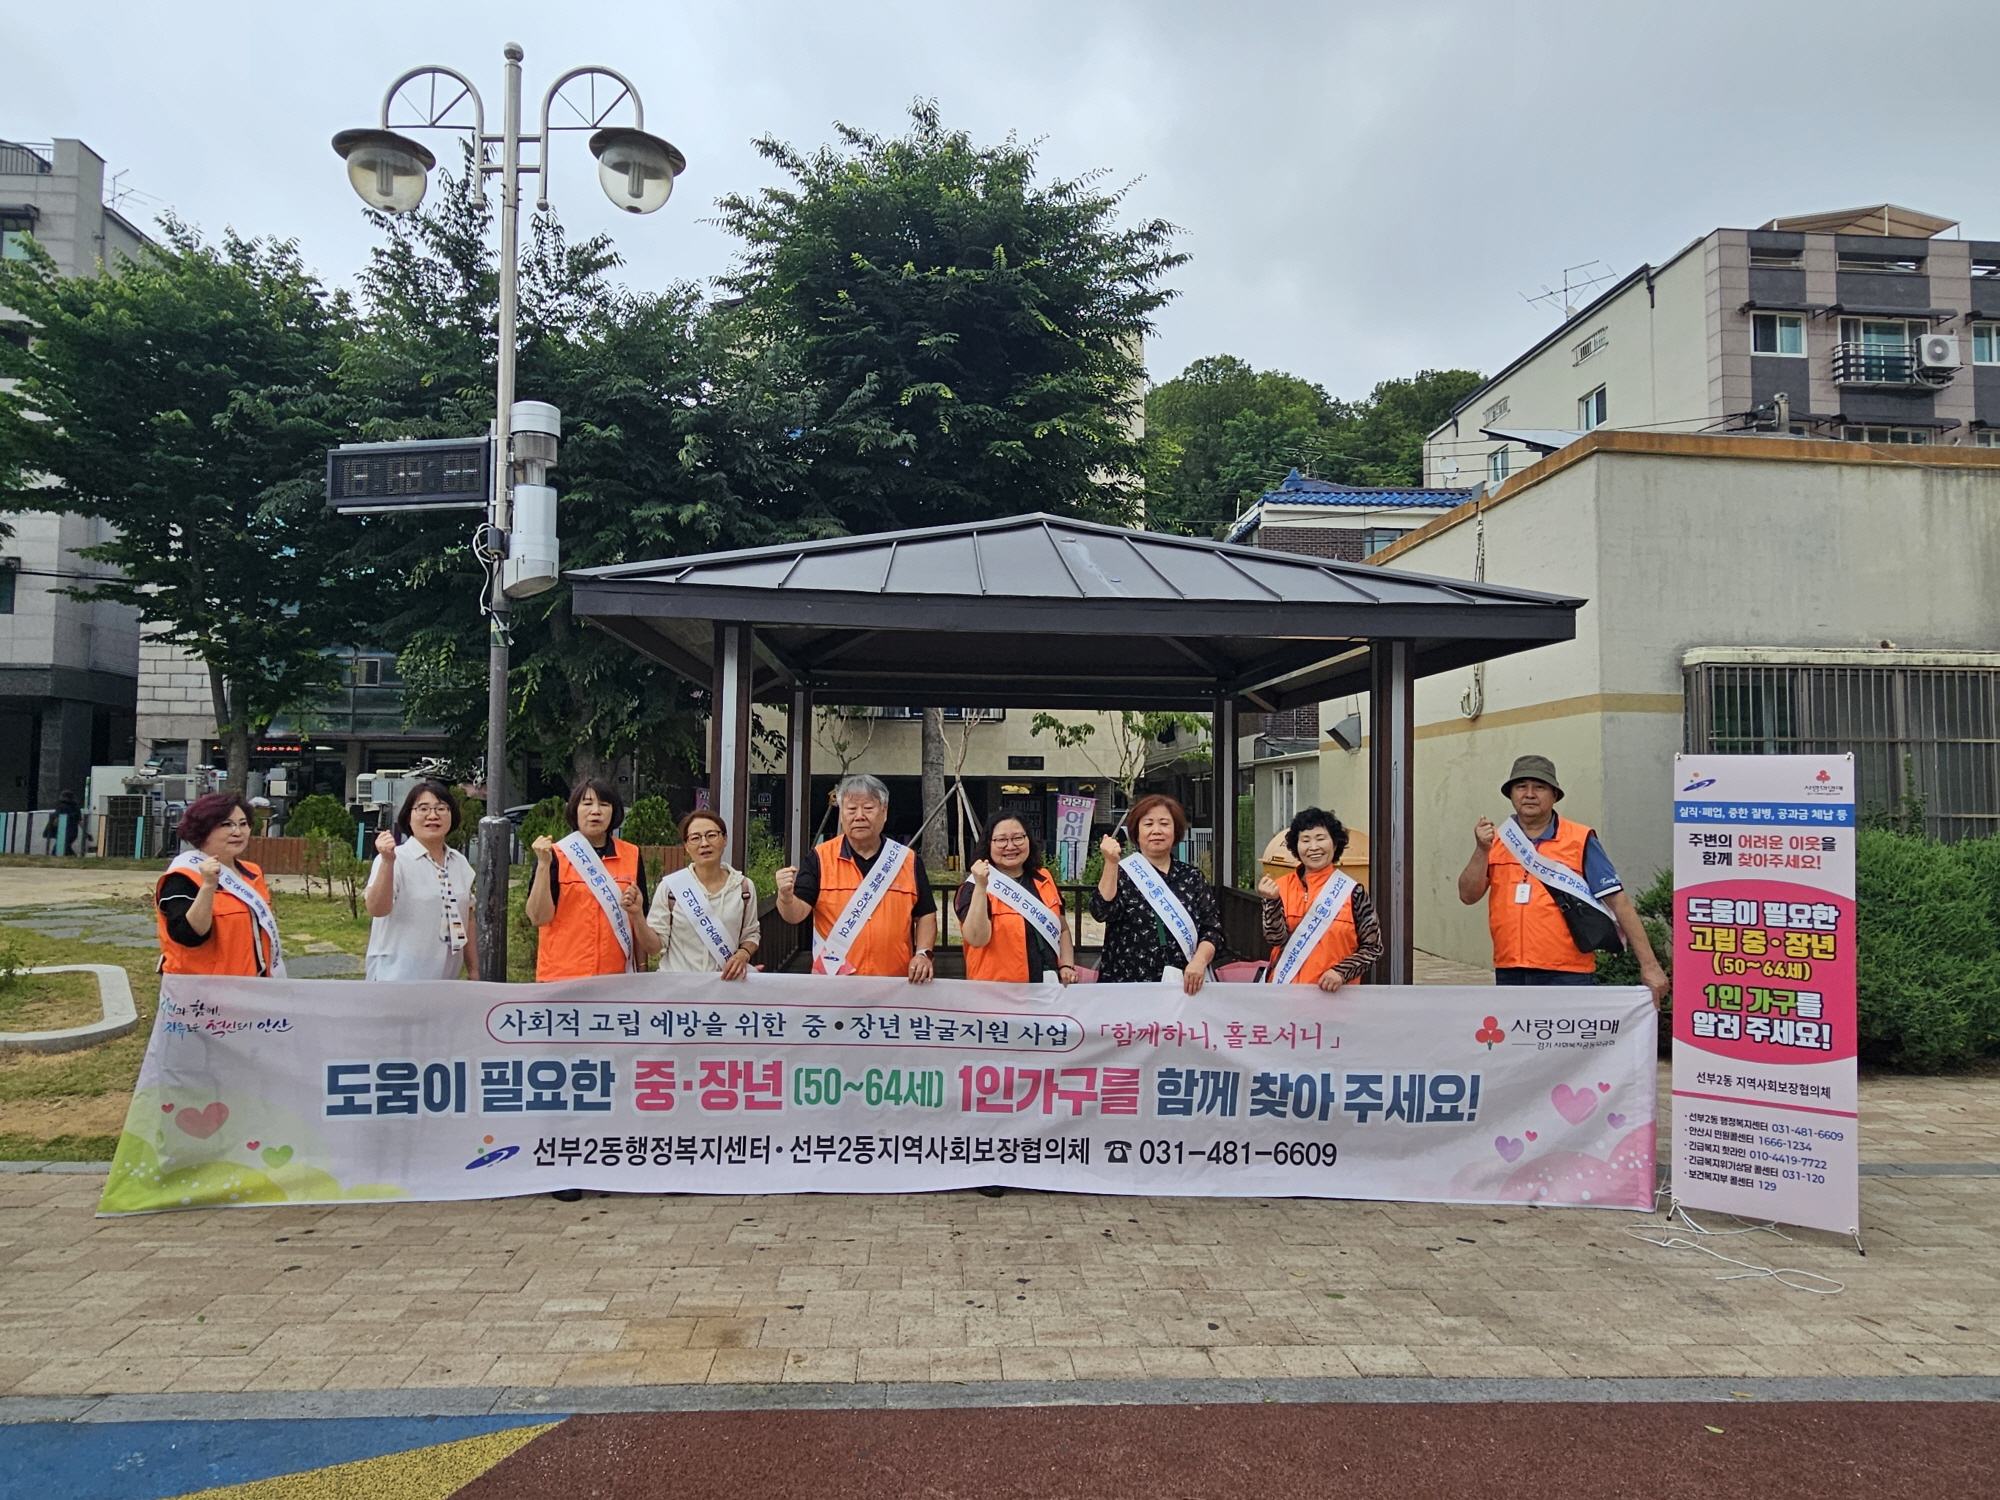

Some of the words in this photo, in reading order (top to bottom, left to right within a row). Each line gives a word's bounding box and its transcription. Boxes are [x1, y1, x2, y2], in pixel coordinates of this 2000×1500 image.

[1728, 807, 1748, 819] 중한
[1751, 808, 1775, 820] 질병,
[1777, 808, 1809, 821] 공과금
[1811, 809, 1834, 821] 체납
[1836, 809, 1848, 821] 등
[569, 841, 591, 865] 안산시
[1688, 832, 1732, 849] 주변의
[1738, 834, 1784, 850] 어려운
[1789, 835, 1836, 852] 이웃을
[1128, 859, 1149, 880] 안산시
[1702, 851, 1732, 867] 함께
[1737, 852, 1822, 870] 찾아주세요!
[868, 872, 886, 893] 함께
[993, 879, 1023, 903] 어려운
[1021, 899, 1048, 925] 이웃을
[1687, 897, 1758, 926] 도움이
[1763, 901, 1840, 931] 필요한
[682, 888, 705, 918] 어려운
[700, 915, 723, 946] 이웃을
[1689, 926, 1737, 953] 고립
[1703, 984, 1743, 1011] 1인
[1747, 987, 1823, 1019] 가구를
[205, 1019, 253, 1039] 혁신도시
[257, 1018, 294, 1033] 안산
[499, 1008, 580, 1037] 사회적
[588, 1009, 640, 1037] 고립
[650, 1009, 728, 1038] 예방을
[734, 1011, 787, 1038] 위한
[909, 1016, 1010, 1045] 발굴지원
[1018, 1017, 1069, 1046] 사업
[1510, 1019, 1620, 1041] 사랑의열매
[1693, 1011, 1740, 1040] 알려
[1745, 1016, 1833, 1050] 주세요!
[326, 1060, 466, 1117] 도움이
[481, 1058, 615, 1114] 필요한
[793, 1067, 945, 1109] (50~64세)
[958, 1063, 1141, 1116] 1인가구를
[1157, 1066, 1241, 1118] 함께
[1249, 1071, 1335, 1123] 찾아
[1343, 1073, 1481, 1124] 주세요!
[1696, 1071, 1733, 1088] 선부2동
[1735, 1077, 1831, 1100] 지역사회보장협의체
[1689, 1112, 1719, 1125] 선부2동
[1720, 1116, 1769, 1132] 행정복지센터
[1771, 1123, 1844, 1142] 031-481-6609
[1689, 1126, 1713, 1138] 안산시
[1714, 1129, 1754, 1144] 민원콜센터
[1758, 1135, 1813, 1152] 1666-1234
[1139, 1138, 1338, 1167] 031-481-6609
[1689, 1140, 1720, 1154] 긴급복지
[1721, 1145, 1746, 1158] 핫라인
[1749, 1150, 1827, 1170] 010-4419-7722
[1688, 1169, 1728, 1184] 보건복지부
[1730, 1175, 1754, 1188] 콜센터
[1758, 1180, 1777, 1192] 129
[1754, 1164, 1779, 1178] 콜센터
[1782, 1169, 1825, 1184] 031-120
